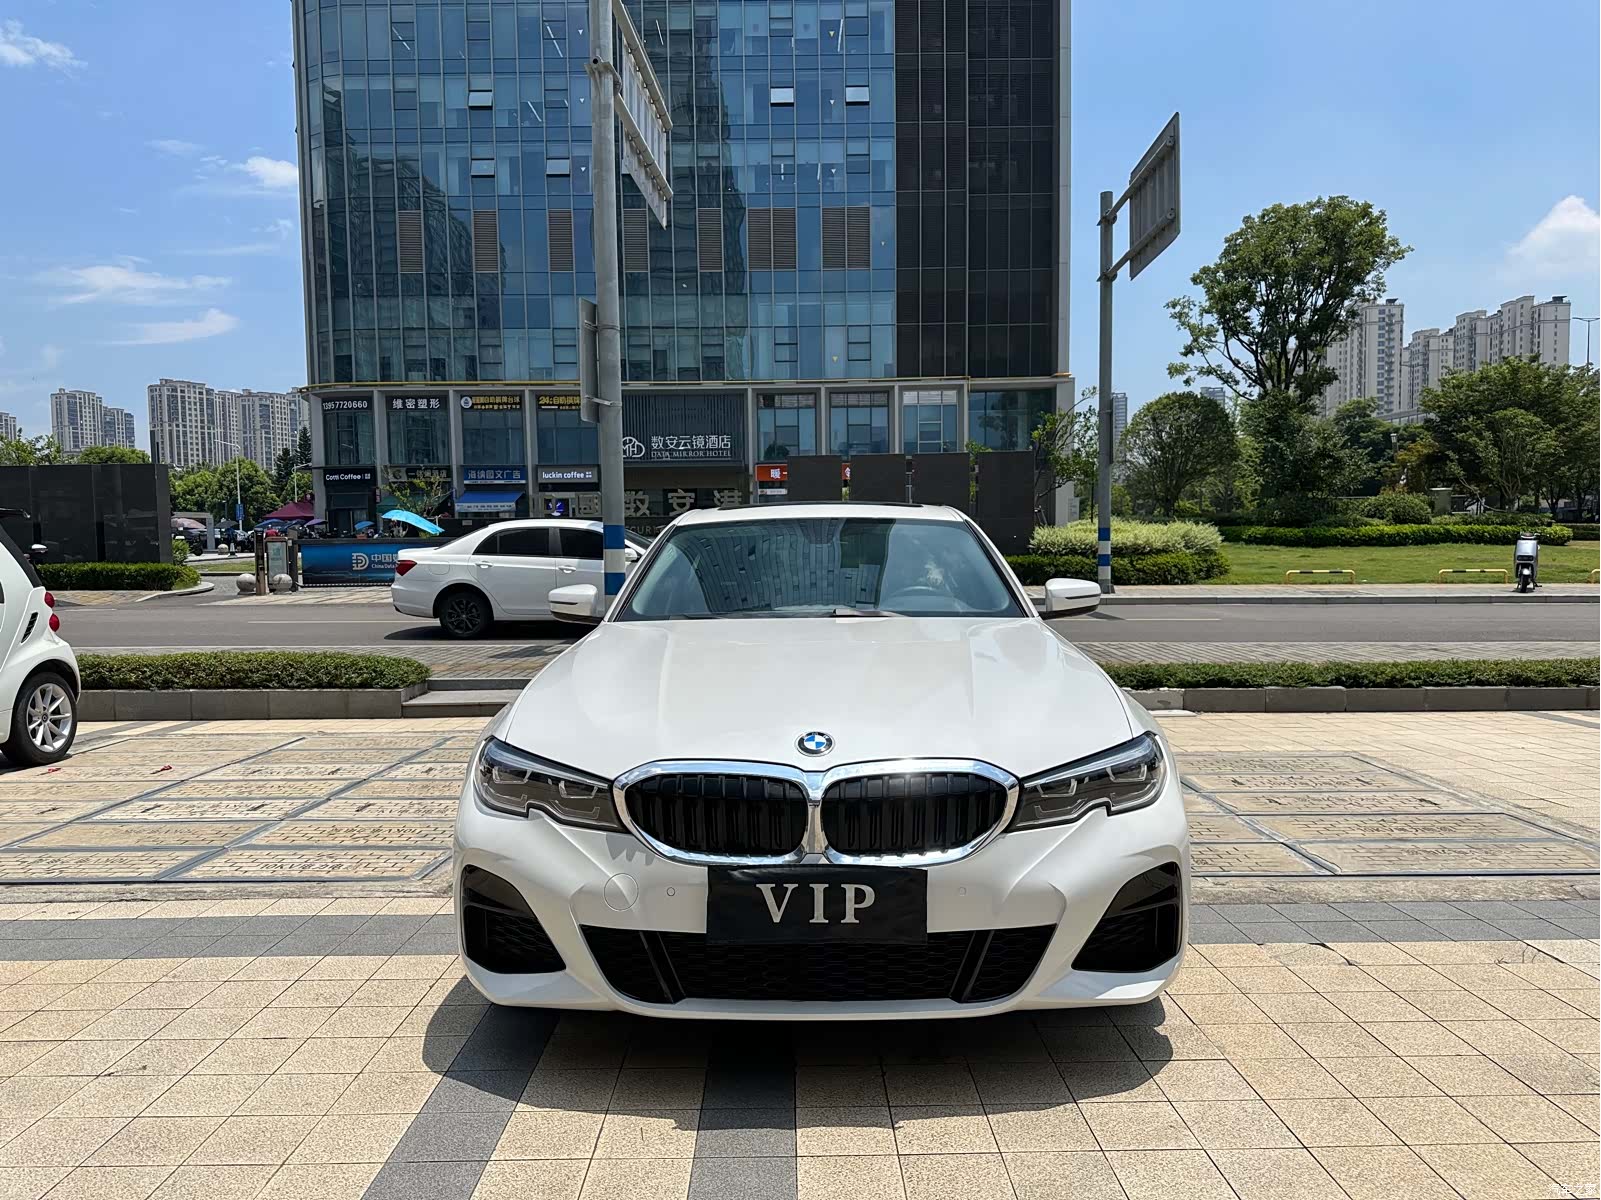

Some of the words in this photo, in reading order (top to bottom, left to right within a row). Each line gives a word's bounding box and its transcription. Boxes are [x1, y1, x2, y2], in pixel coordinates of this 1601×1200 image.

[322, 400, 368, 410] 13957720660
[392, 398, 440, 409] 维密塑形
[651, 435, 731, 449] 数安云镜酒店
[651, 450, 670, 458] DATA
[706, 449, 731, 457] HOTEL
[542, 471, 562, 479] luckin
[563, 471, 584, 479] coffee
[756, 883, 876, 923] VIP
